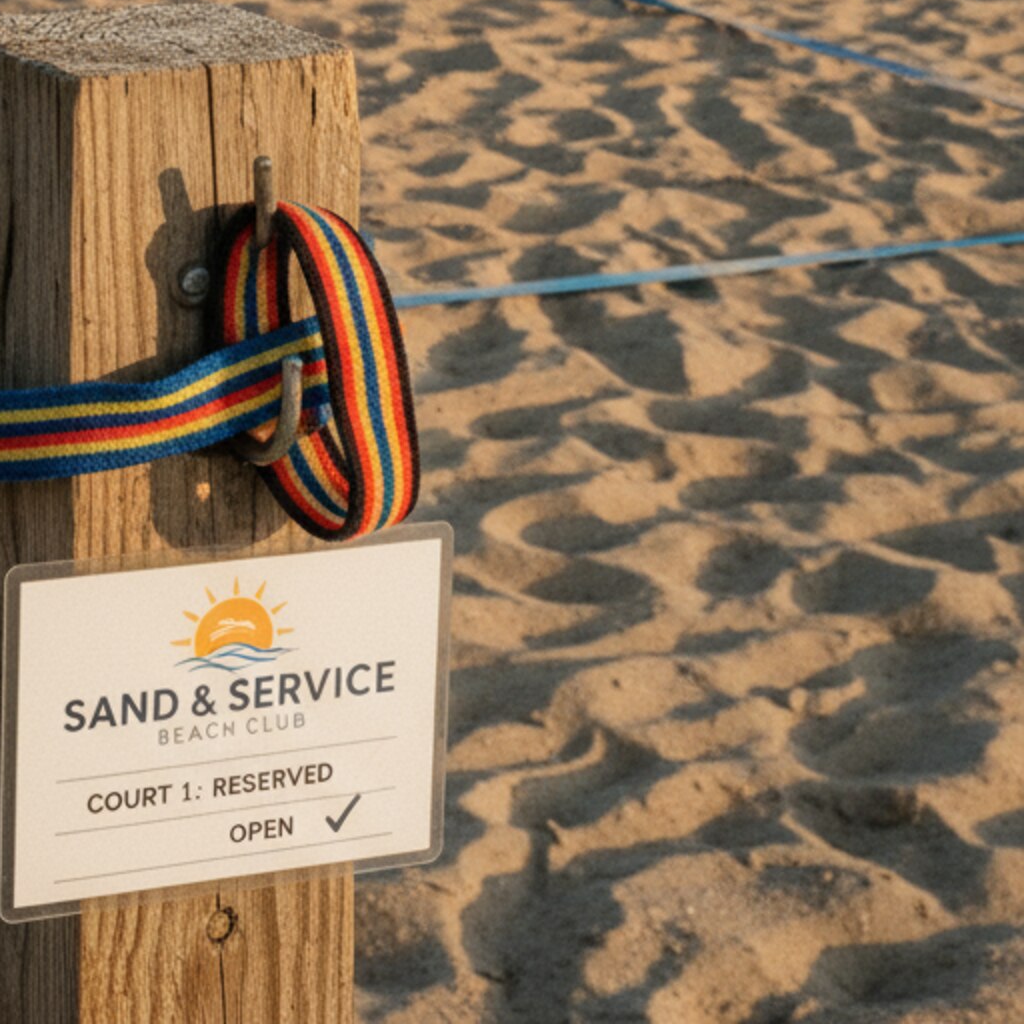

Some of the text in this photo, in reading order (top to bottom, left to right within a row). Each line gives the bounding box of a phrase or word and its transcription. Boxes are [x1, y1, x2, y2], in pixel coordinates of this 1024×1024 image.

[64, 661, 396, 733] SAND & SERVICE
[157, 712, 306, 746] BEACH CLUB
[87, 784, 172, 815] COURT
[213, 762, 333, 797] RESERVED
[229, 816, 294, 843] OPEN
